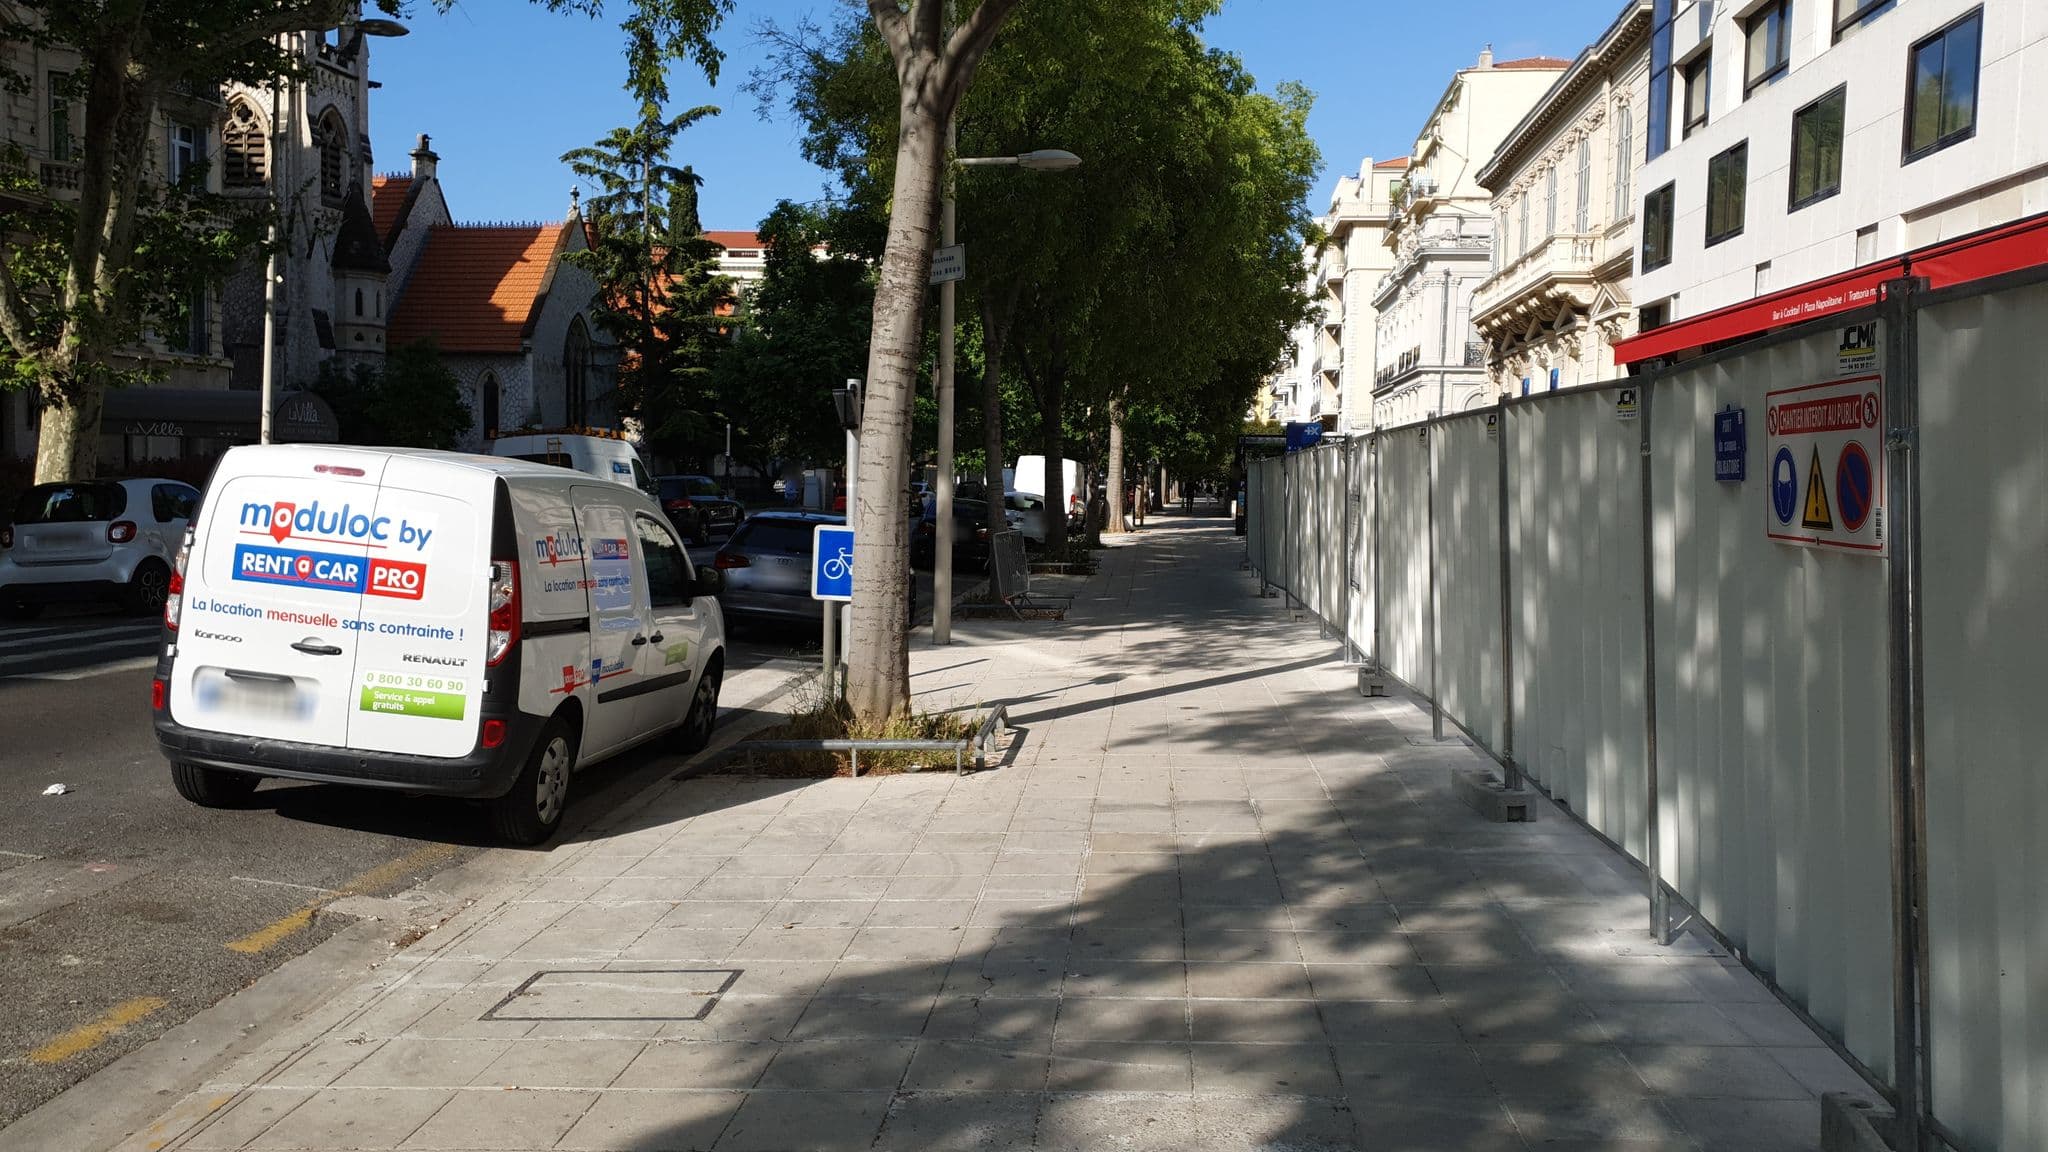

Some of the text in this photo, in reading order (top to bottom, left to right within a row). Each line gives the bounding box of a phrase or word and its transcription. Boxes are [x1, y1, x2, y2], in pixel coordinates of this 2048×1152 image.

[1784, 304, 1800, 317] Cocktail
[1805, 302, 1816, 312] Pizza
[1816, 296, 1842, 310] Napolitaine
[1849, 287, 1869, 301] Trattoria
[1780, 401, 1860, 430] CHANTIER INTERDIT AU PUBLIC
[137, 420, 185, 436] Villa
[240, 500, 433, 552] moduloc by
[536, 532, 585, 559] moduloc
[242, 552, 294, 574] RENT
[314, 562, 359, 582] CAR
[373, 566, 420, 588] PRO
[553, 579, 576, 592] location
[192, 597, 206, 611] La
[211, 598, 263, 618] location
[267, 609, 338, 628] mensuelle
[342, 618, 375, 632] sans
[380, 623, 454, 640] contrainte
[402, 653, 468, 668] RENAULT
[366, 672, 464, 691] 0 800 30 60 90
[372, 700, 404, 712] gratuits
[374, 690, 403, 703] Service
[412, 694, 435, 706] appel
